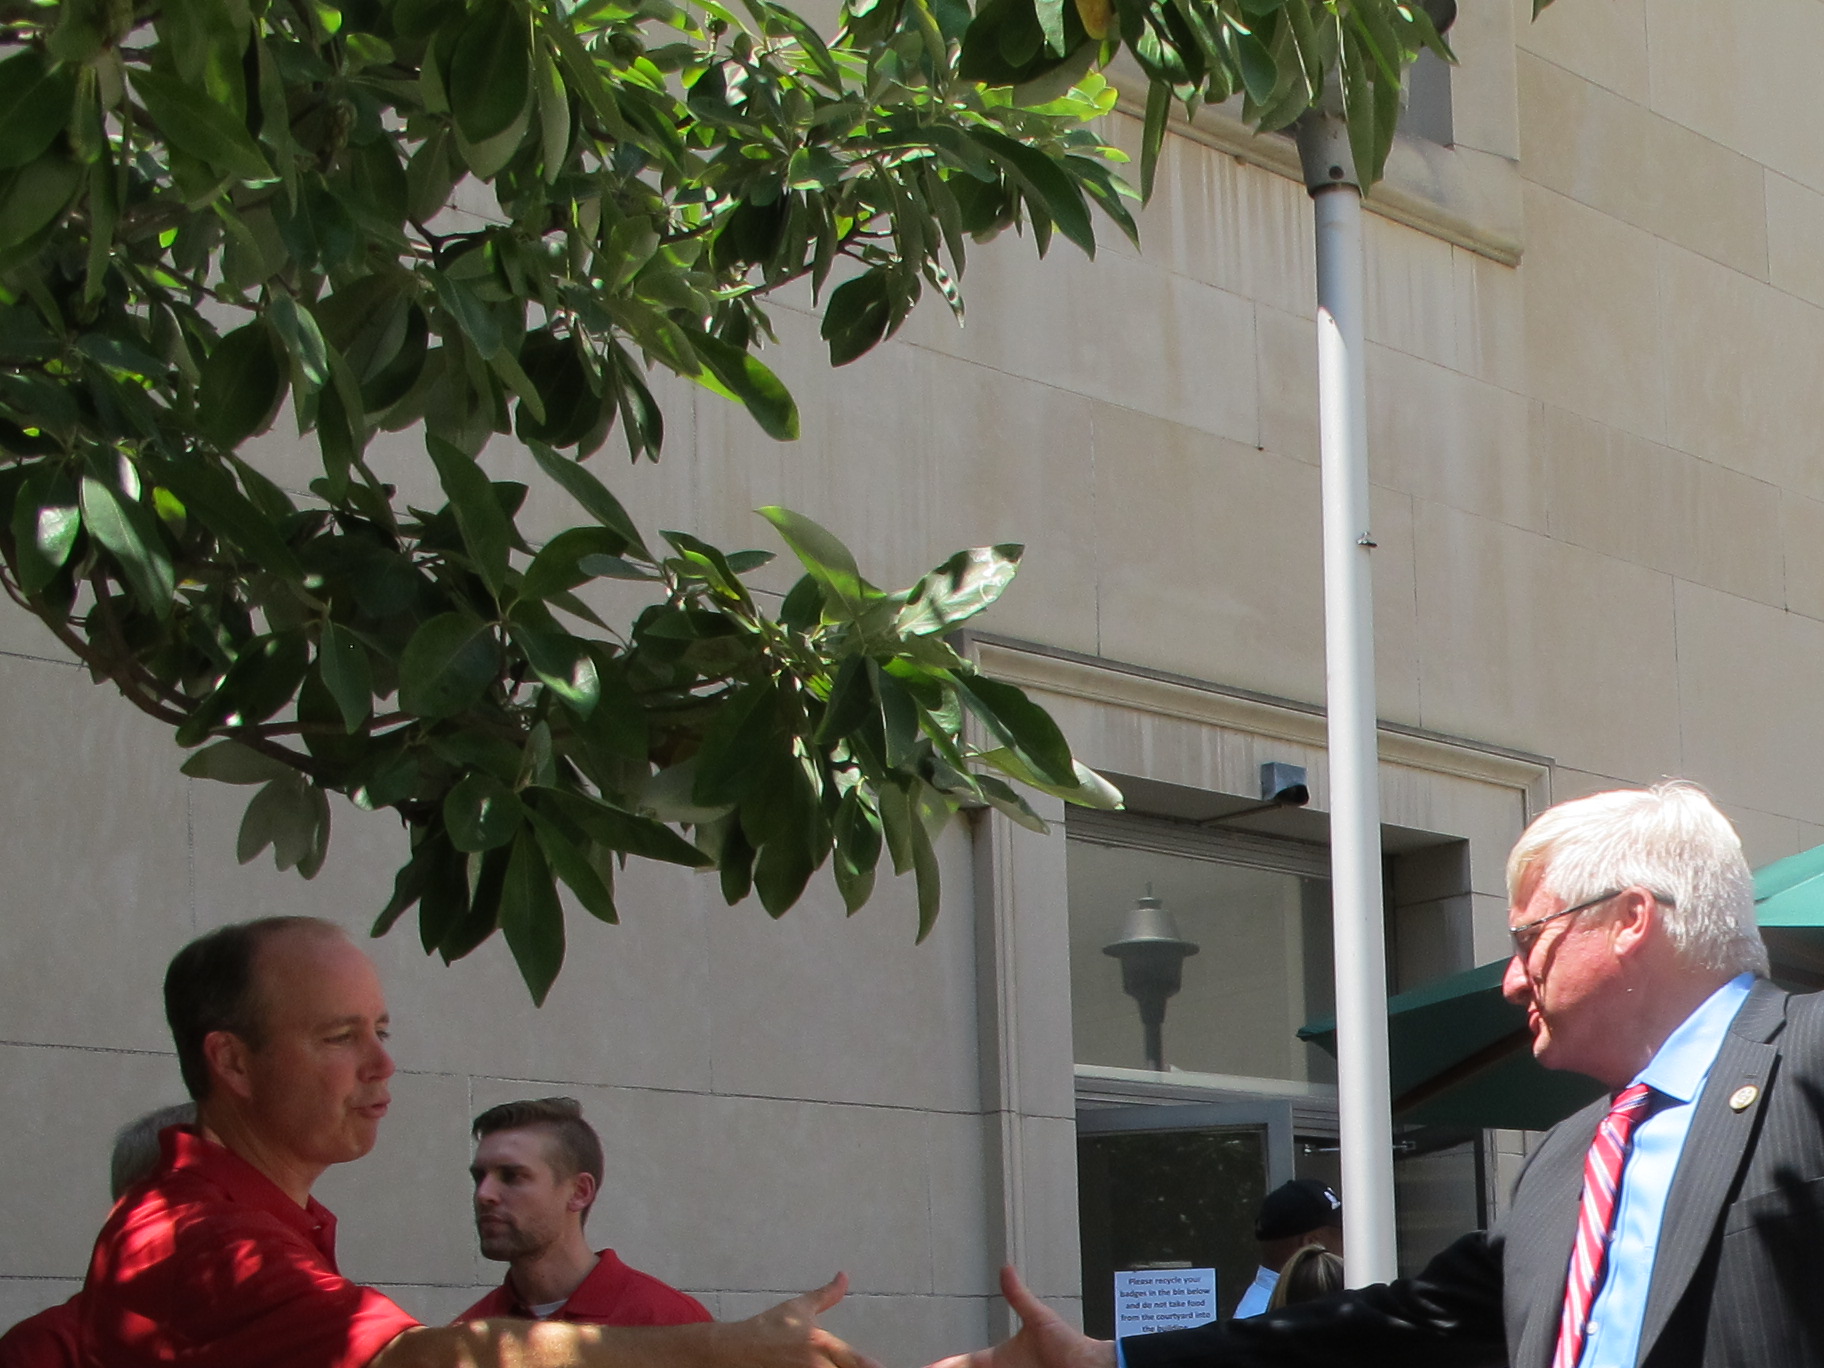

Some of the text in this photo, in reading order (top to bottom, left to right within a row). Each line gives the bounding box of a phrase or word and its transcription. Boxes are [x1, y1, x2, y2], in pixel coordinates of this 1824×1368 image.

[1128, 1276, 1201, 1285] Please recycle your
[1120, 1289, 1147, 1298] badges
[1158, 1288, 1171, 1296] the
[1187, 1287, 1211, 1295] below
[1187, 1299, 1206, 1307] food
[1121, 1313, 1140, 1321] from
[1156, 1312, 1194, 1321] courtyard
[1195, 1311, 1211, 1319] into
